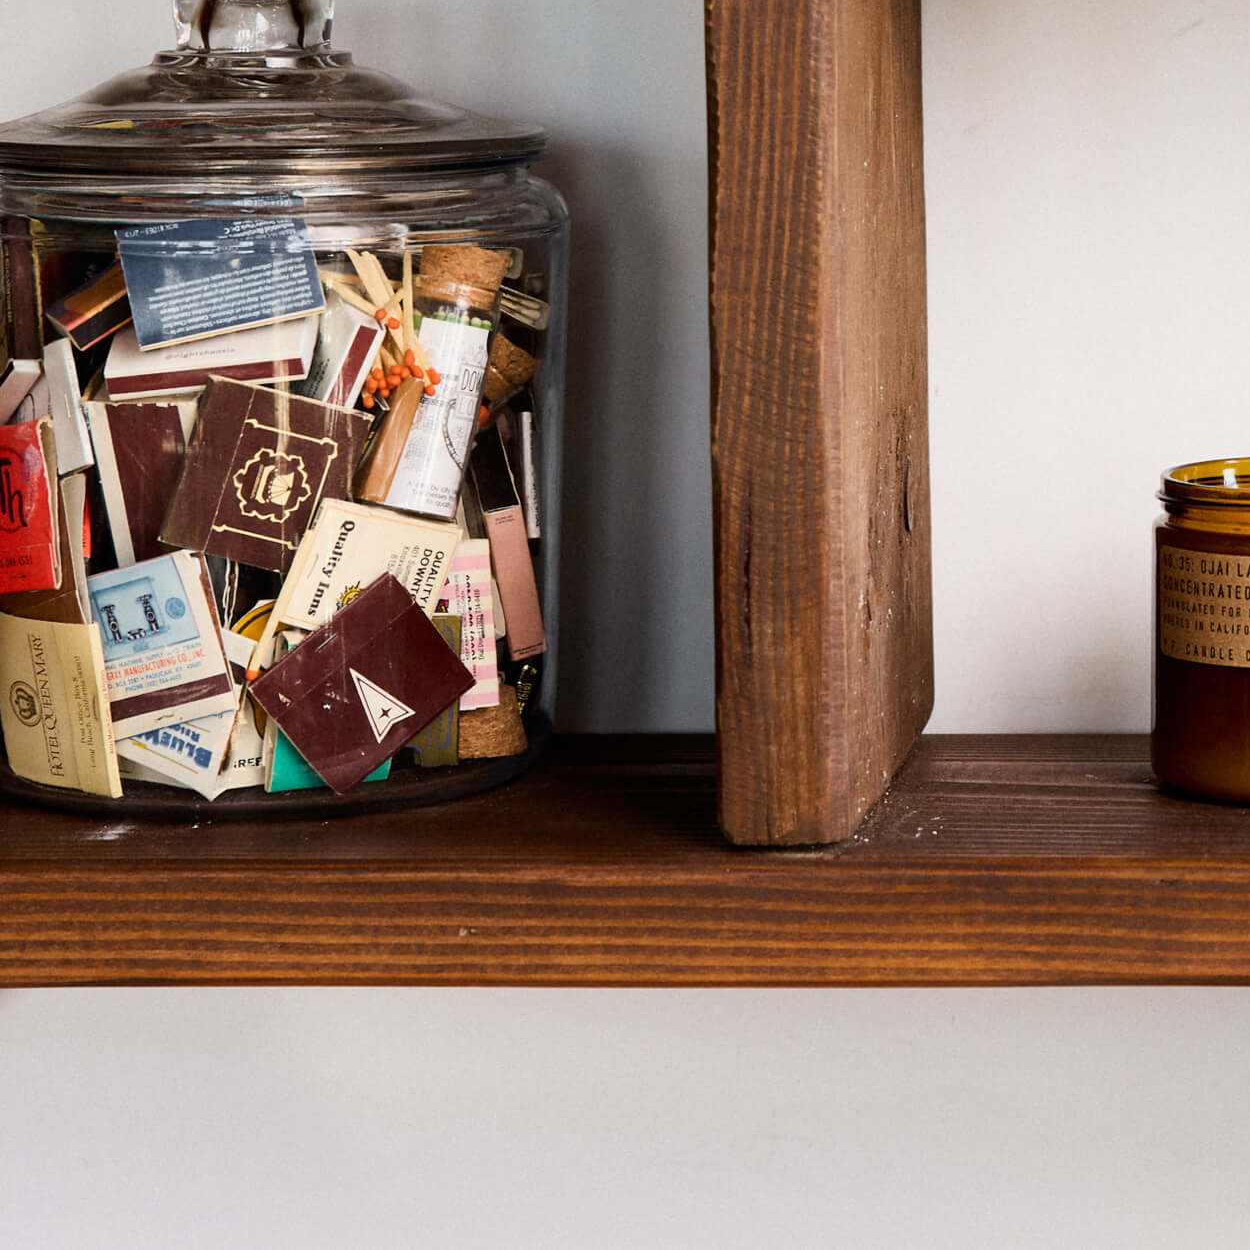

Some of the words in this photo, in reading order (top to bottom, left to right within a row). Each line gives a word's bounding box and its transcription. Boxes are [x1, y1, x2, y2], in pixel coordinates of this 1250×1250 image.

[322, 520, 356, 578] Quality
[422, 551, 445, 603] QUALITY
[1200, 559, 1230, 578] OJAI
[308, 582, 330, 616] Inns
[1221, 605, 1242, 618] FOR
[1194, 621, 1205, 632] IN
[31, 634, 48, 677] MARY
[1185, 643, 1235, 663] CANDLE
[37, 678, 58, 731] QUEEN
[45, 731, 65, 777] HOTEL
